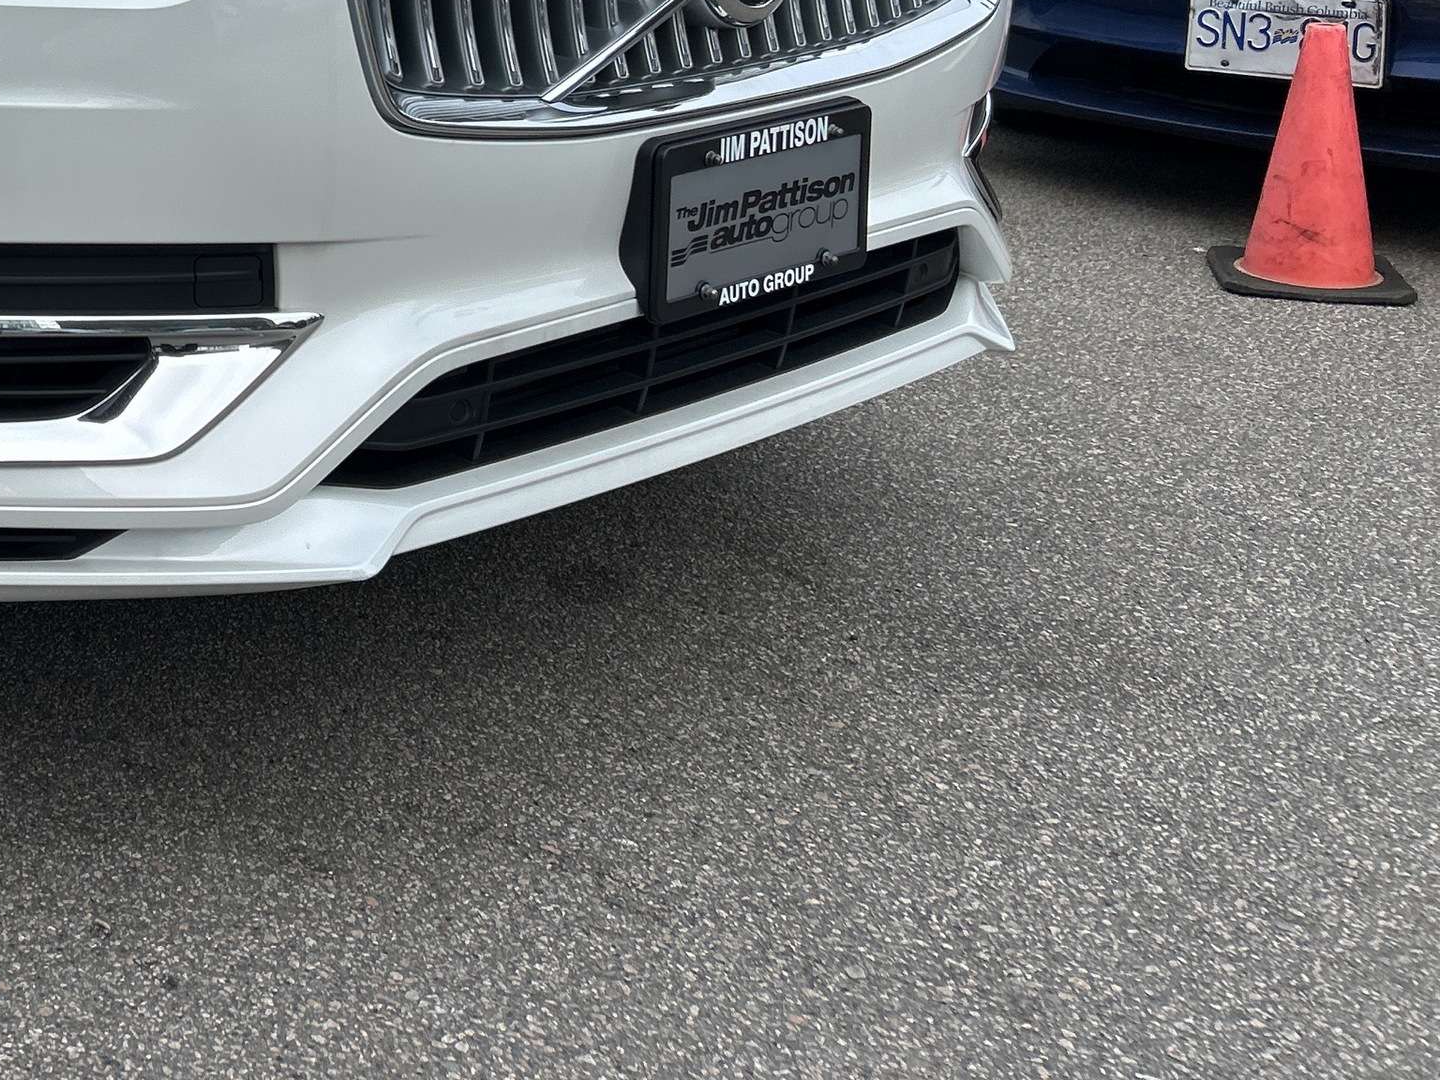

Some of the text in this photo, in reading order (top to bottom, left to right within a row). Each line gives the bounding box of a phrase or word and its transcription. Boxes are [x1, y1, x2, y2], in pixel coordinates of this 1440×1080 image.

[1265, 1, 1304, 16] British
[1306, 5, 1369, 21] Columbia
[720, 116, 830, 163] JIM PATTISON
[676, 205, 698, 220] The
[718, 264, 815, 307] AUTO GROUP
